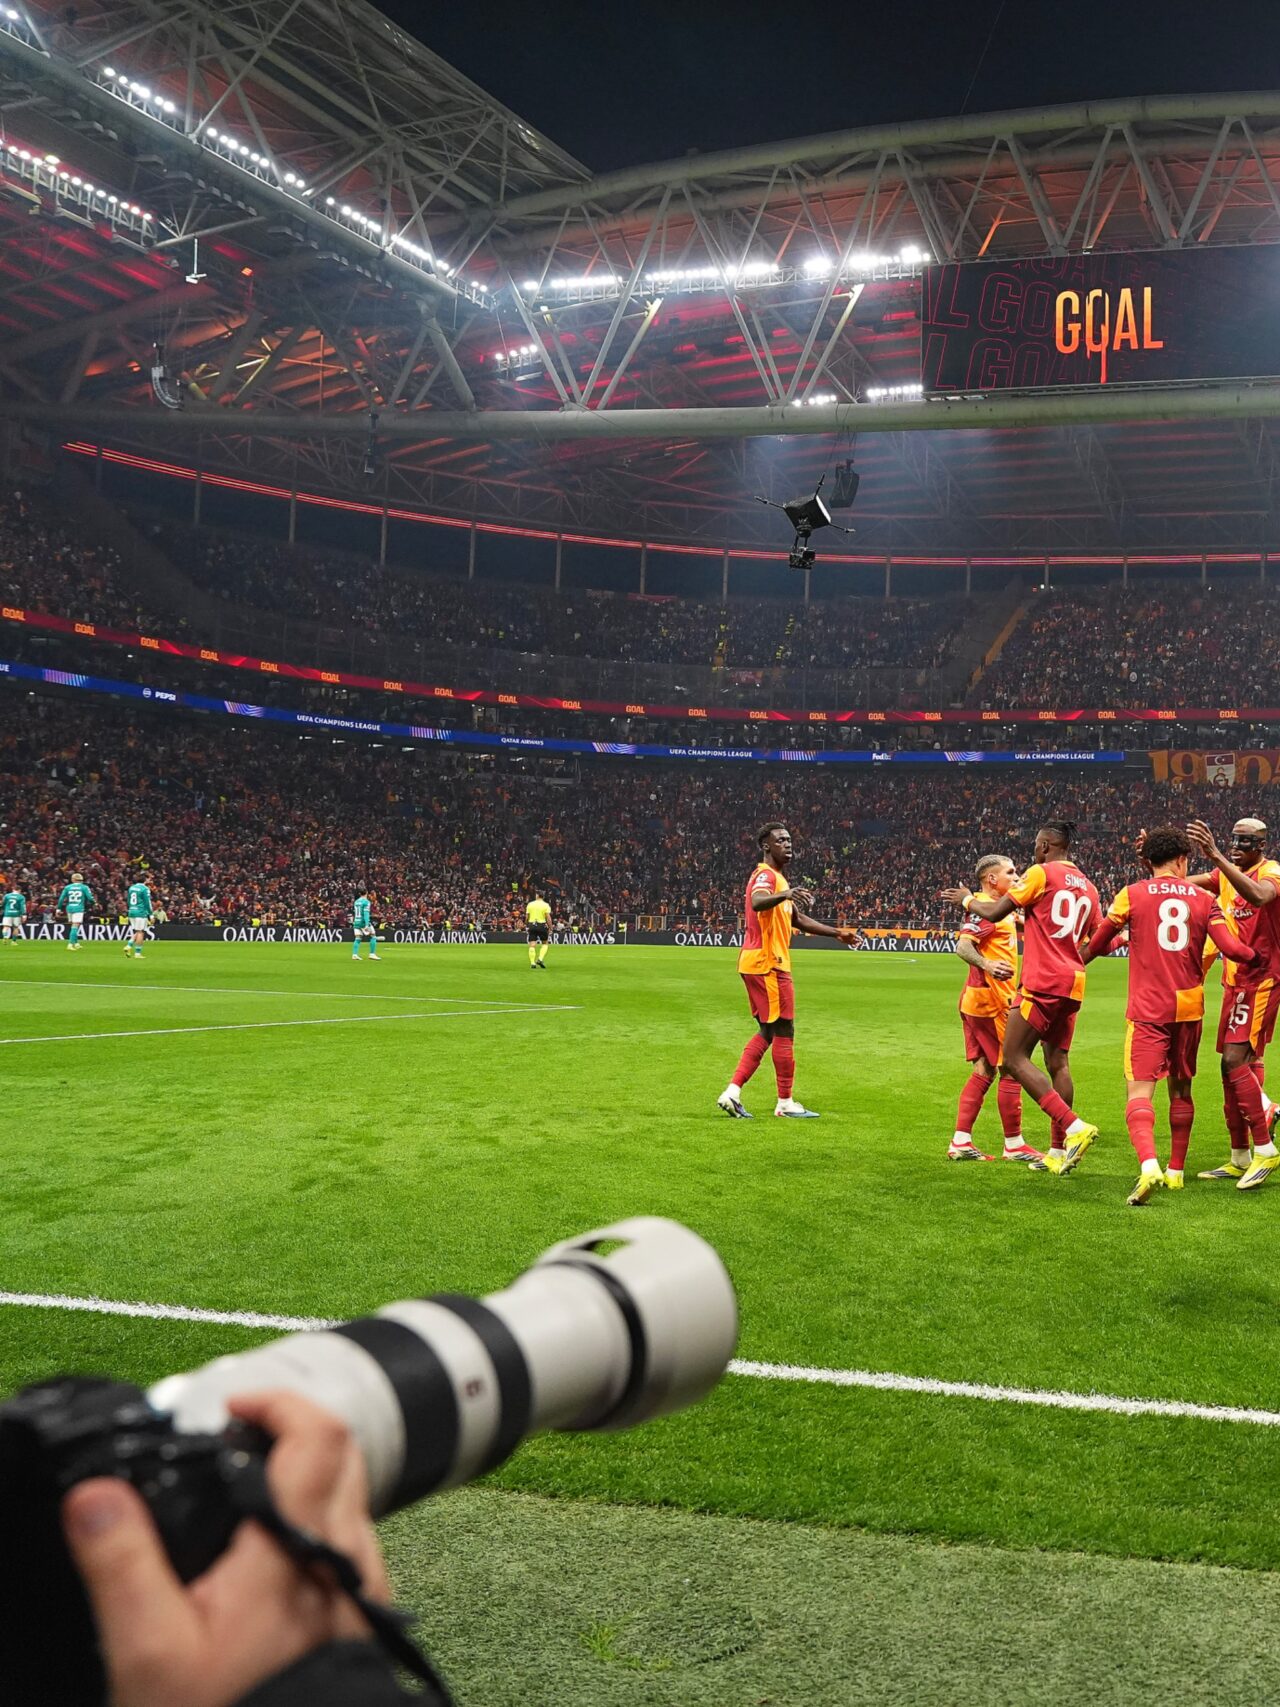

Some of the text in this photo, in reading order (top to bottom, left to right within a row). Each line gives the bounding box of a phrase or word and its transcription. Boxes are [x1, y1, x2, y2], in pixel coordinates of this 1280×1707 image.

[1055, 287, 1164, 384] GOAL
[2, 607, 25, 620] GOAL
[75, 623, 95, 635] GOAL
[140, 637, 159, 648] GOAL
[200, 650, 218, 661] GOAL
[260, 661, 278, 672] GOAL
[321, 672, 339, 682] GOAL
[384, 681, 402, 690] GOAL
[155, 691, 176, 701] PEPSI
[434, 688, 453, 696] GOAL
[498, 695, 517, 703] GOAL
[562, 700, 581, 709] GOAL
[625, 705, 644, 713] GOAL
[688, 708, 706, 716] GOAL
[924, 712, 942, 720] GOAL
[1038, 711, 1056, 719] GOAL
[296, 715, 381, 731] UEFA CHAMPIONS LEAGUE
[669, 748, 752, 758] UEFA CHAMPIONS LEAGUE
[1148, 882, 1197, 897] G.SARA
[68, 890, 83, 903] 22
[129, 892, 138, 905] 8
[1050, 889, 1092, 944] 90
[1157, 898, 1190, 952] 8
[76, 924, 156, 941] AIRWAS
[223, 927, 343, 943] QATAR AIRWAYS
[394, 930, 487, 944] QATAR AIRWAYS
[675, 932, 722, 947] QATAR
[903, 938, 958, 953] AIRWAY
